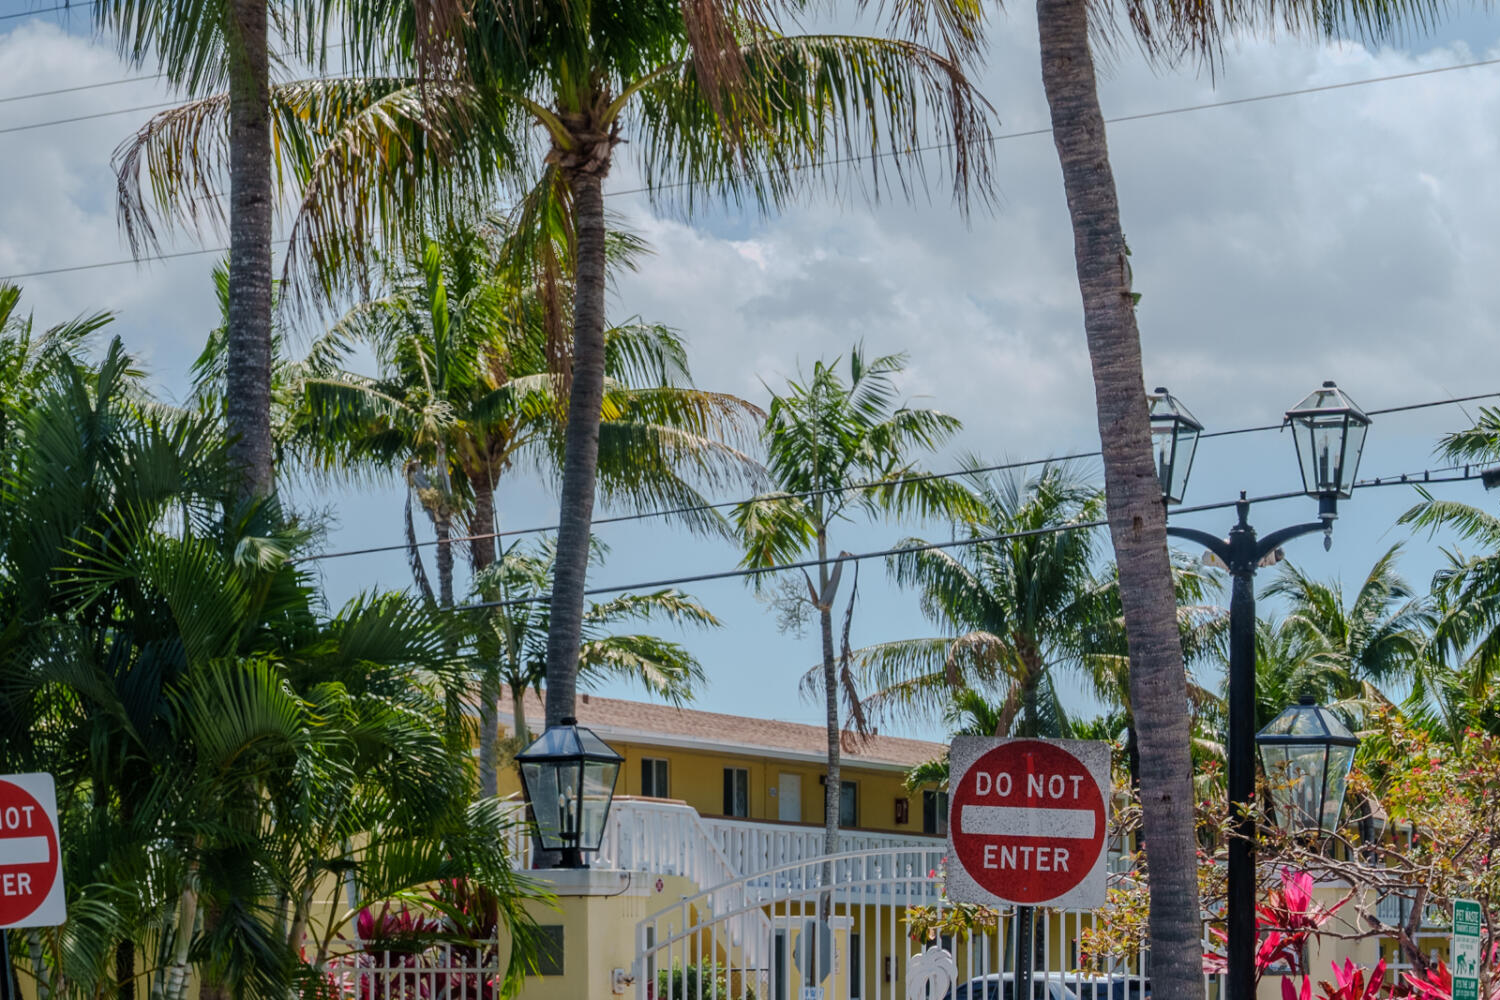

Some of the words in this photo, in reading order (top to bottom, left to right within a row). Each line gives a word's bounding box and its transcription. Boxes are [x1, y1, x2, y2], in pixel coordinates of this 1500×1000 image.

[975, 771, 1012, 797] DO
[1027, 773, 1084, 800] NOT
[983, 844, 1070, 873] ENTER
[0, 872, 32, 897] ER
[1456, 909, 1464, 921] PET
[1465, 910, 1479, 923] WASTE
